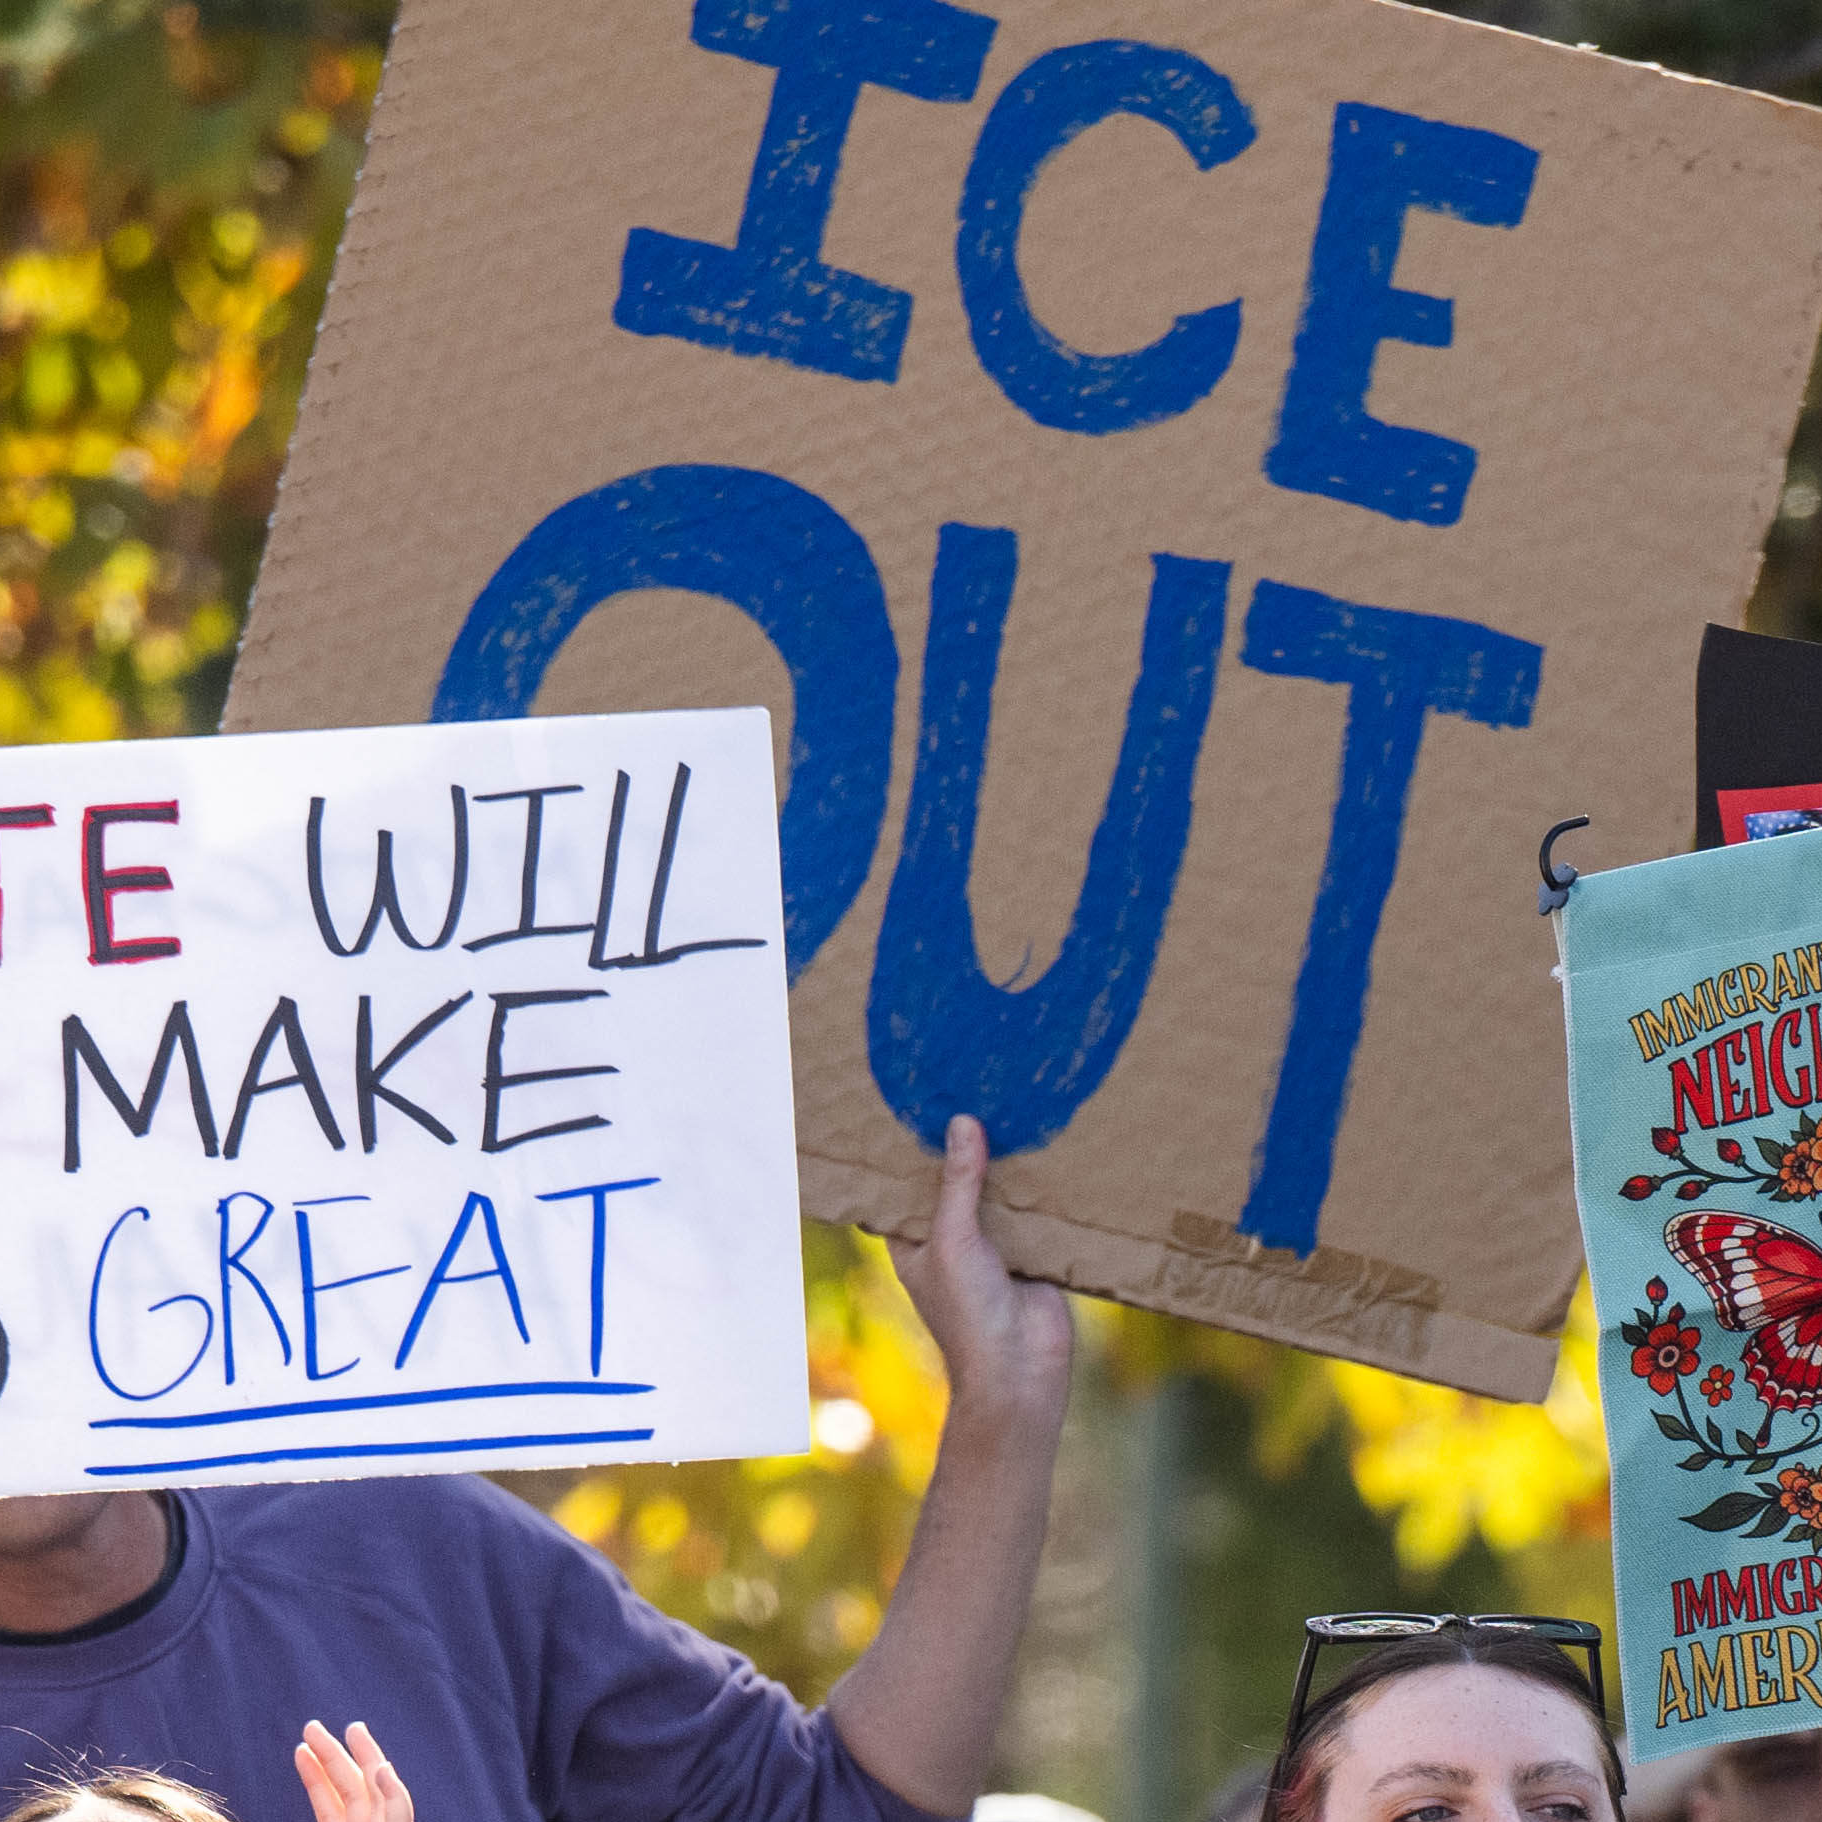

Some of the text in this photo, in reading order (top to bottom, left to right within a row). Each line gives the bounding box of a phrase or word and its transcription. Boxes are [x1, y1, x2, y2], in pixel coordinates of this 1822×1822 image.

[612, 0, 1541, 527] ICE
[306, 762, 767, 968] WILL
[432, 463, 1545, 1260] OUT
[62, 989, 621, 1173] MAKE
[89, 1177, 662, 1400] GREAT
